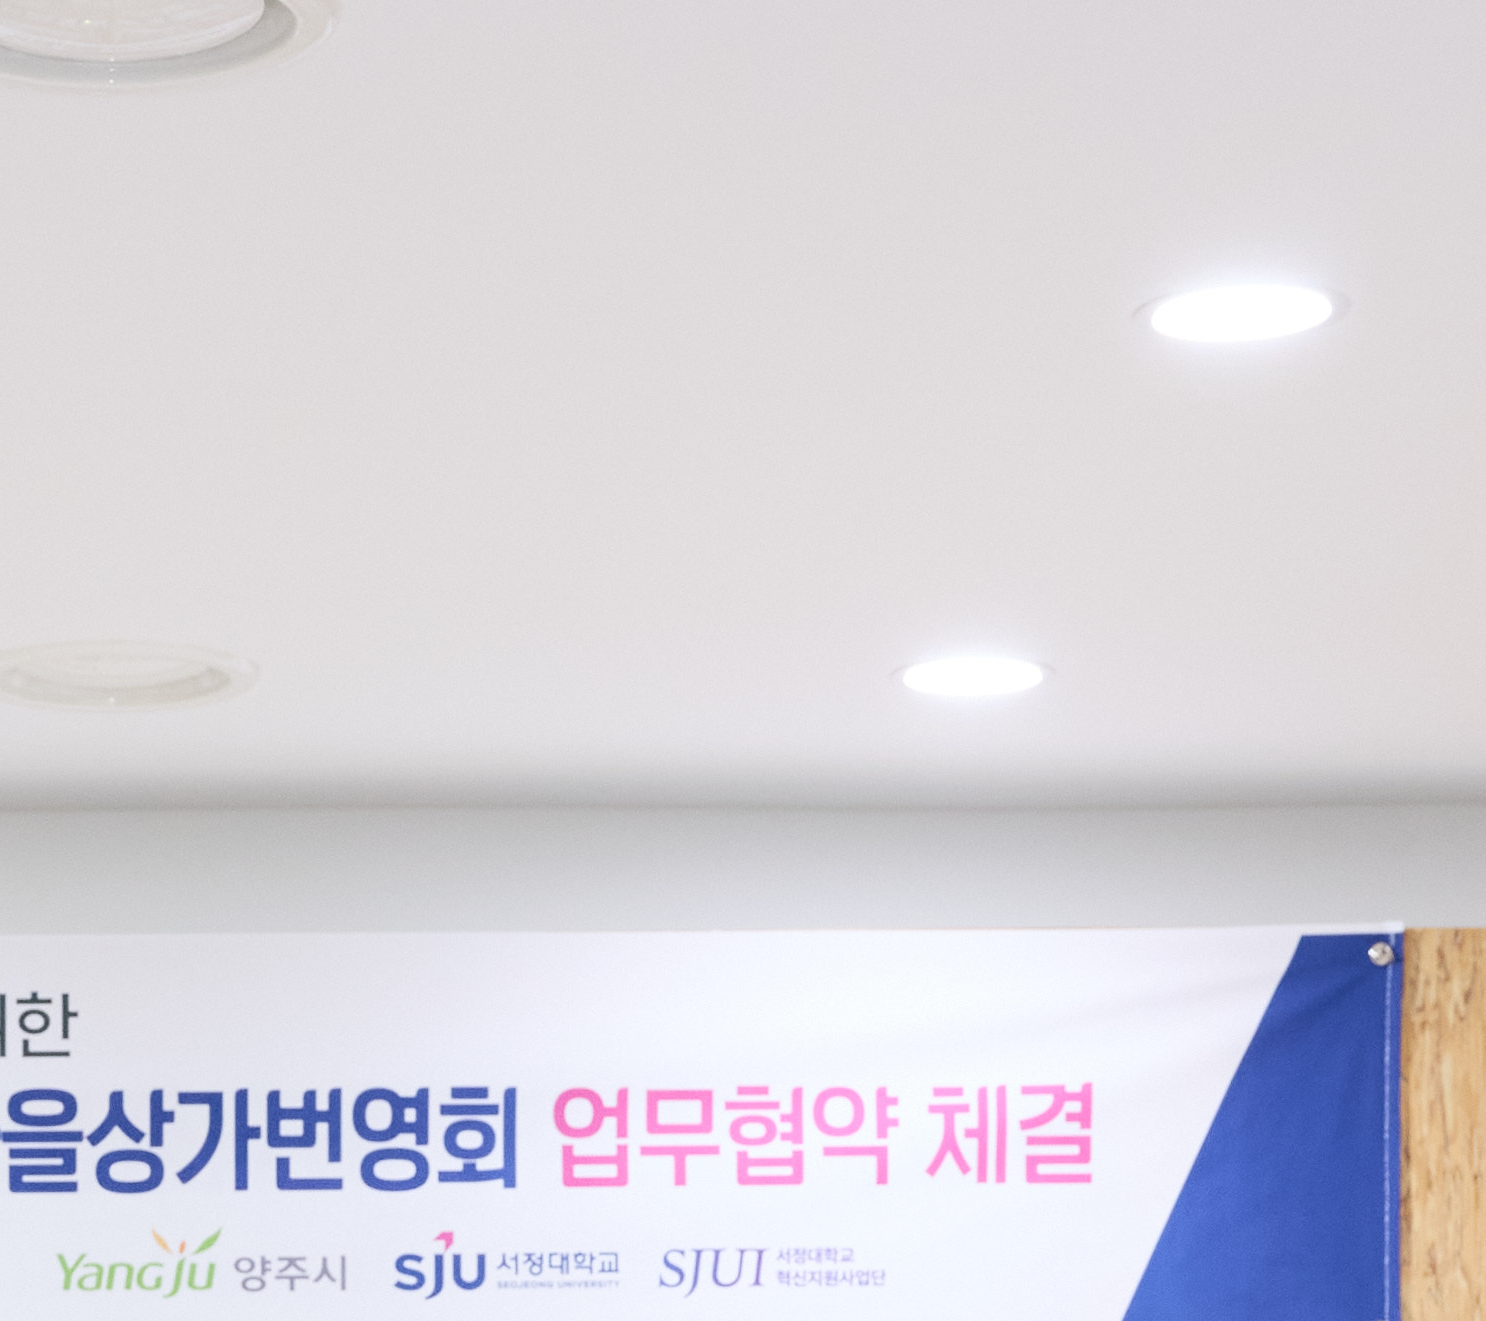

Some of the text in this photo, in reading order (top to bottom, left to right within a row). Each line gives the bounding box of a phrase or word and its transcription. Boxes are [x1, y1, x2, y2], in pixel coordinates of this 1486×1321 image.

[550, 1083, 901, 1190] 업무협약
[923, 1080, 1096, 1186] 체결
[233, 1255, 348, 1293] 양주시
[497, 1251, 620, 1277] 서정대학교
[657, 1247, 769, 1299] SJUI
[776, 1247, 856, 1265] 서정대학교
